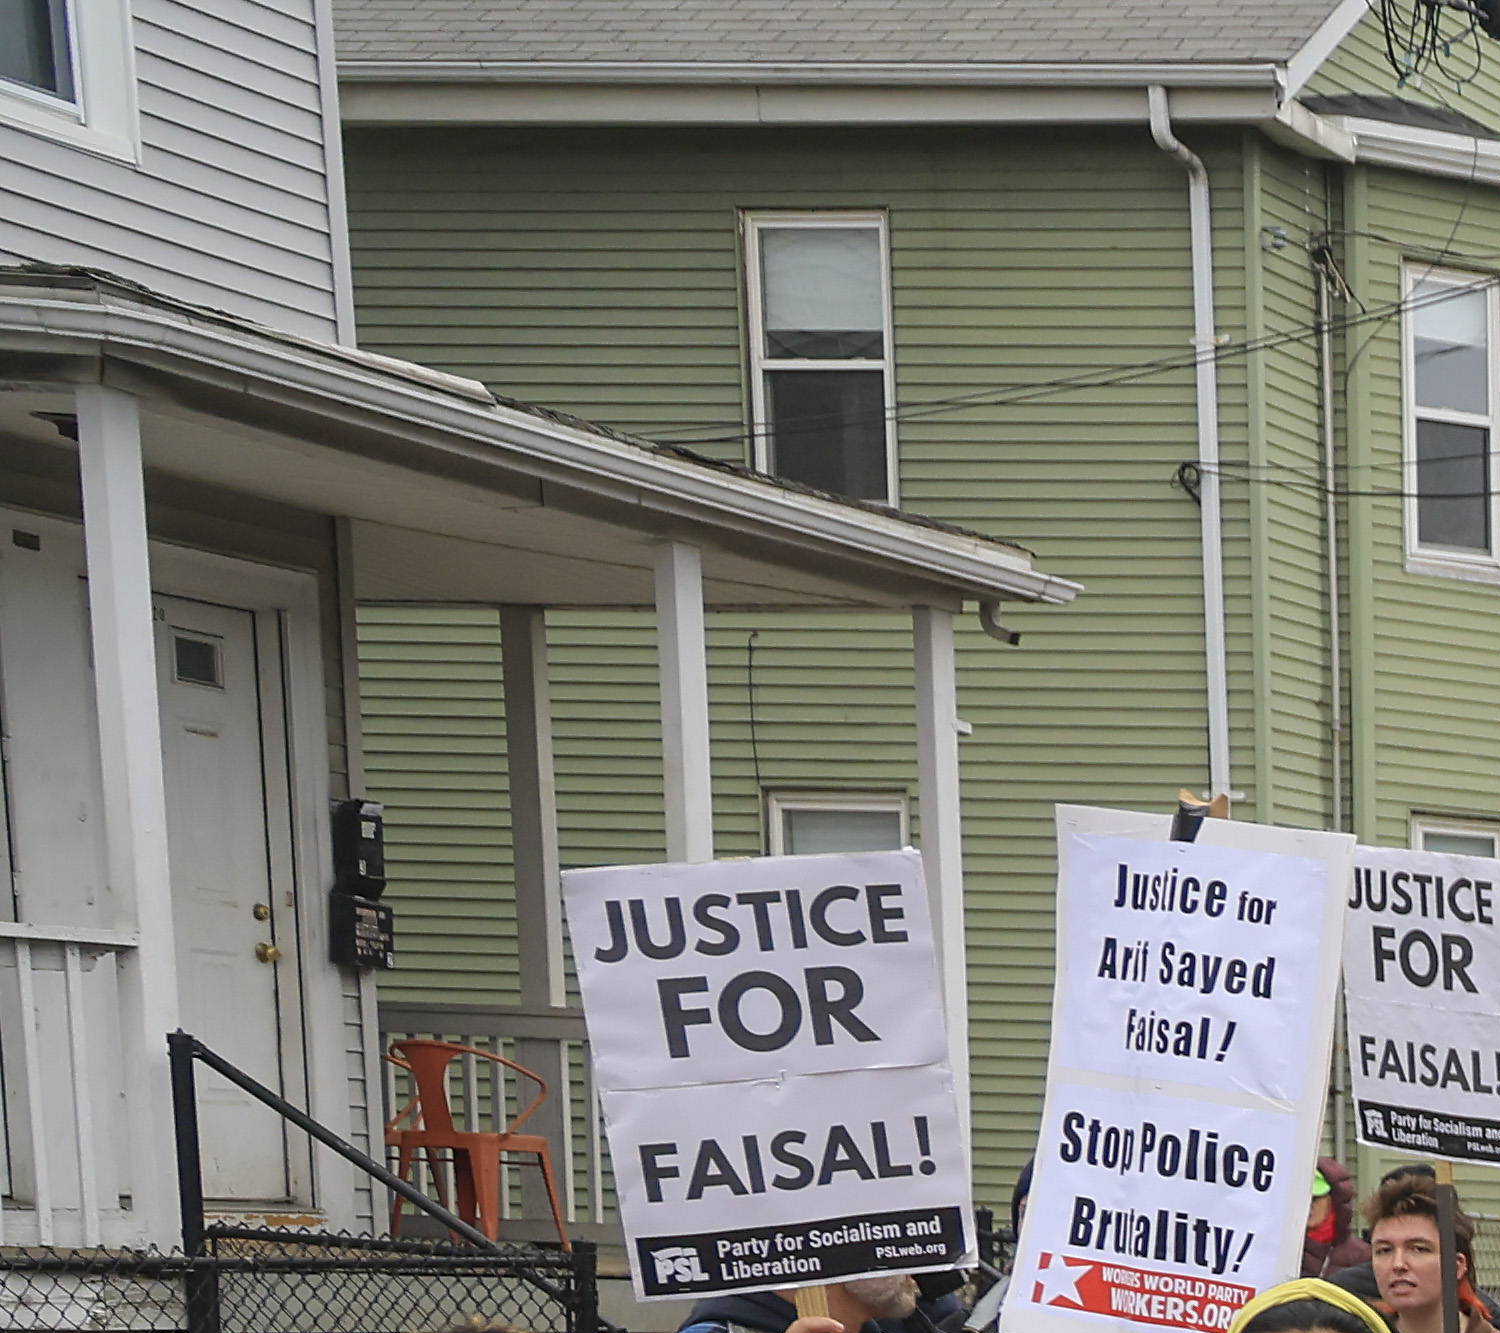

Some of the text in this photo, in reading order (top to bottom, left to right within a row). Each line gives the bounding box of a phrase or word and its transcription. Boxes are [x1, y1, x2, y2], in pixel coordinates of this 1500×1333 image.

[1114, 863, 1277, 925] Justice for
[1348, 866, 1494, 925] JUSTICE
[595, 884, 909, 963] JUSTICE
[1098, 936, 1276, 999] Arif Sayed
[1372, 925, 1478, 994] FOR
[656, 966, 881, 1059] FOR
[1366, 1115, 1389, 1139] PSL
[1390, 1110, 1417, 1131] Party
[1419, 1114, 1431, 1130] for
[1433, 1117, 1483, 1139] Socialism
[1391, 1128, 1439, 1148] Liberation
[638, 1116, 937, 1203] FAISAL!
[717, 1216, 941, 1258] Party for Socialism and
[876, 1243, 946, 1259] PSLweb.org
[1068, 1196, 1254, 1275] Brutality!
[654, 1254, 709, 1284] PSL
[721, 1255, 821, 1281] Liberation
[1101, 1266, 1249, 1305] WORKERS WORLD PARTY
